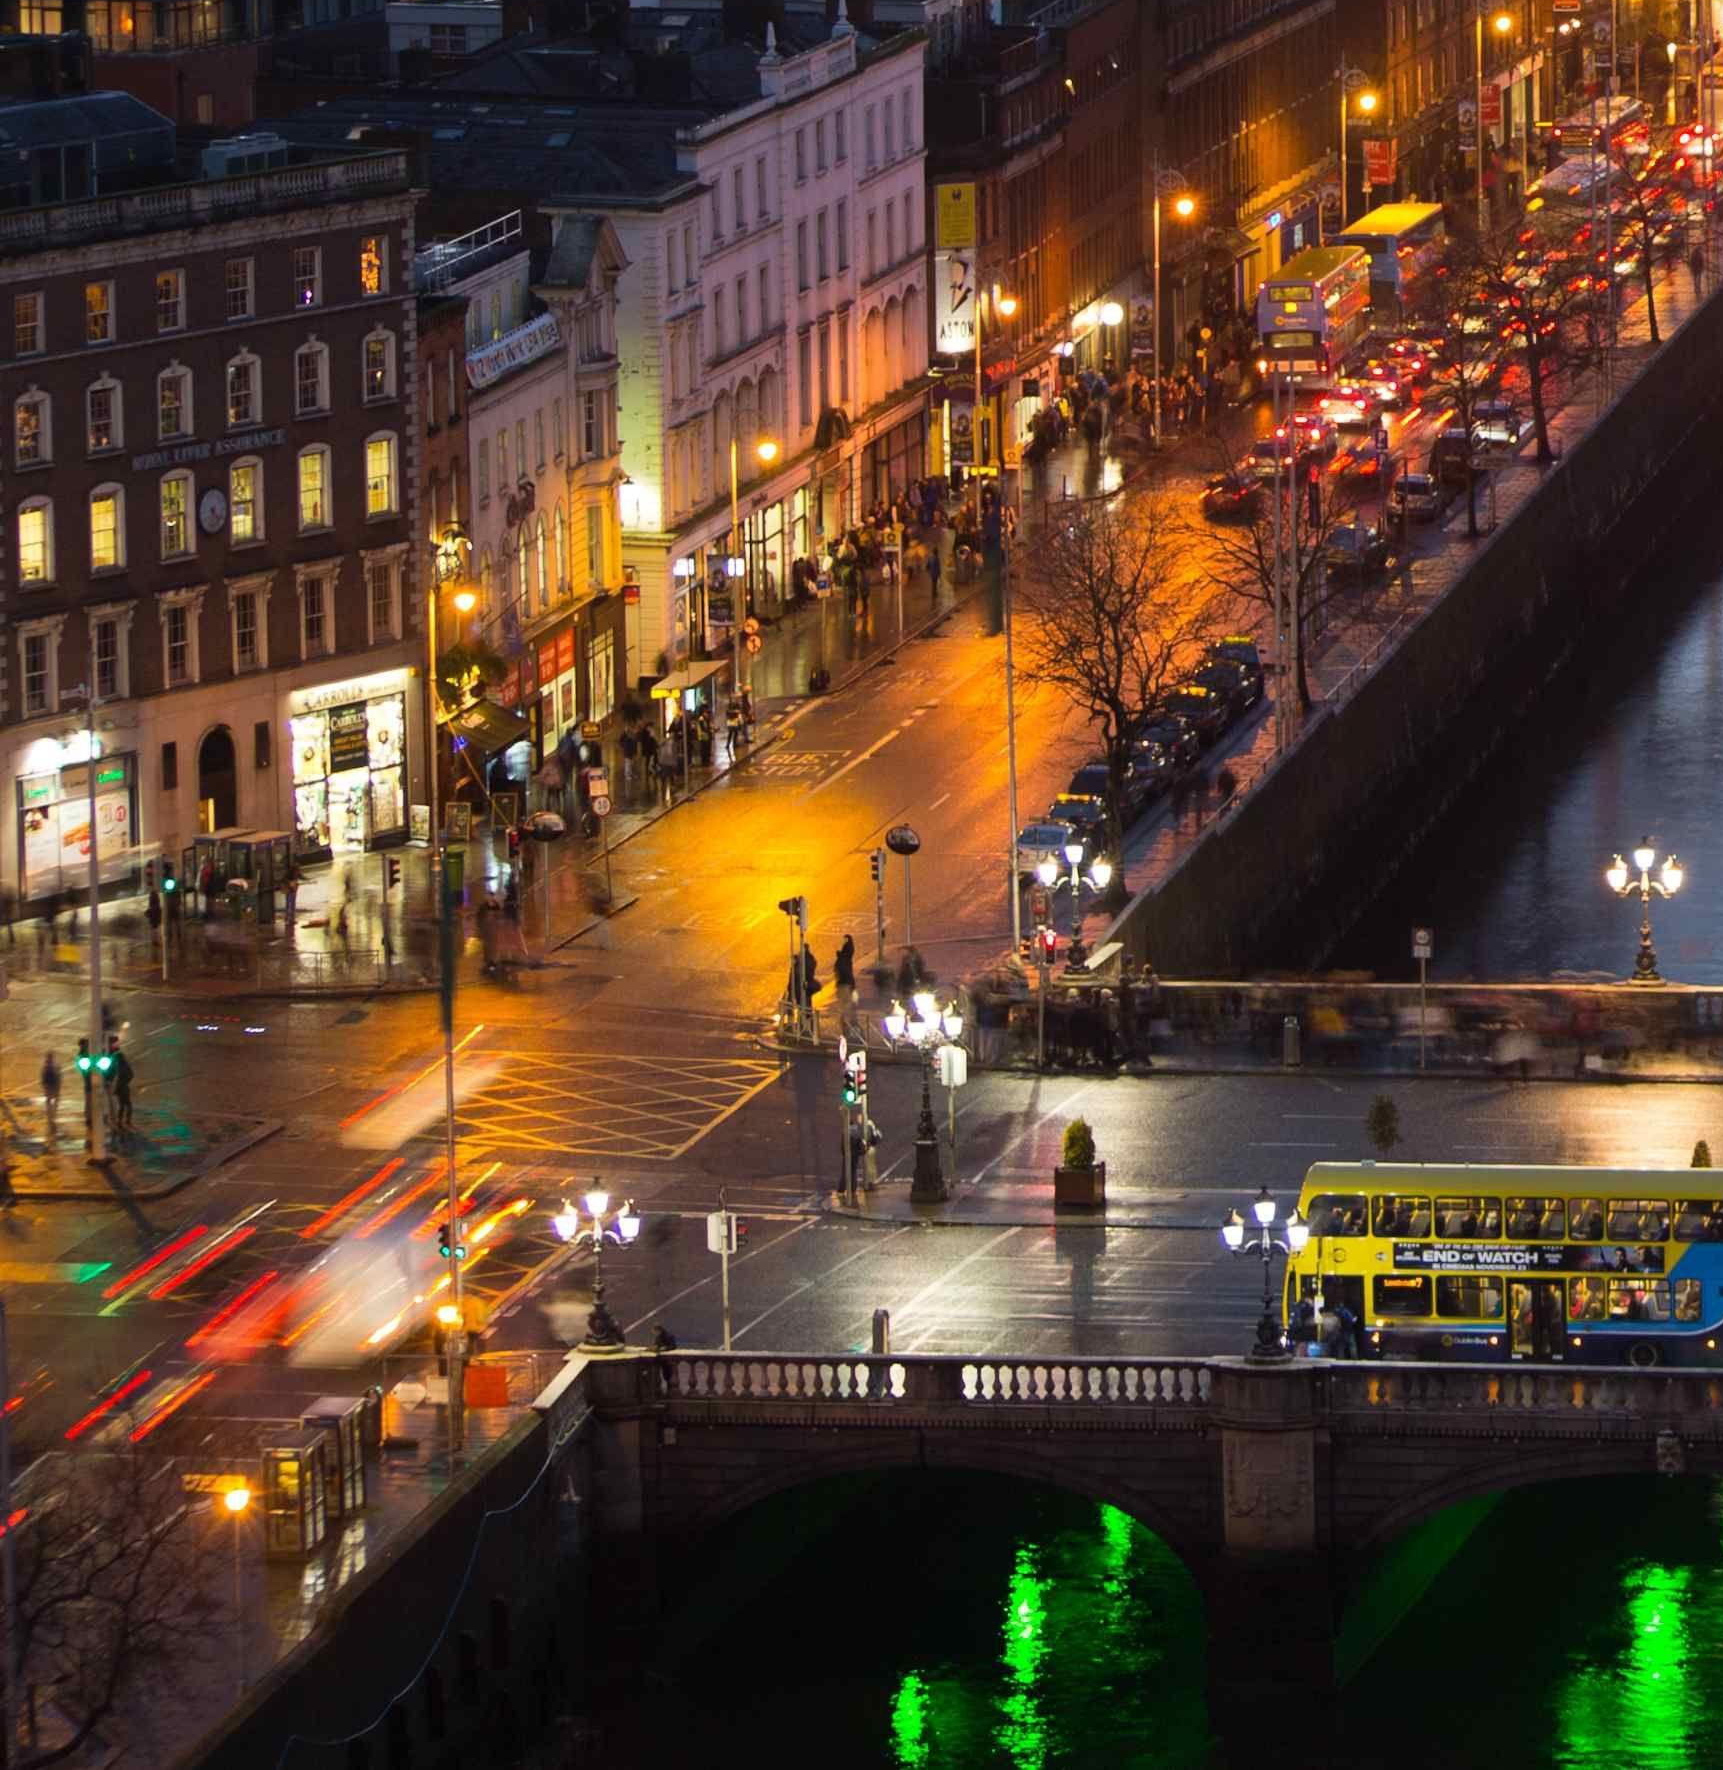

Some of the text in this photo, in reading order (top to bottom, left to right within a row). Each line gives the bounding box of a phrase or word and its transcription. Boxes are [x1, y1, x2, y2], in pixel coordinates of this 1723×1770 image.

[940, 320, 974, 340] ASTON
[1423, 1250, 1460, 1263] END
[1462, 1253, 1474, 1261] OF
[1478, 1251, 1538, 1265] WATCH
